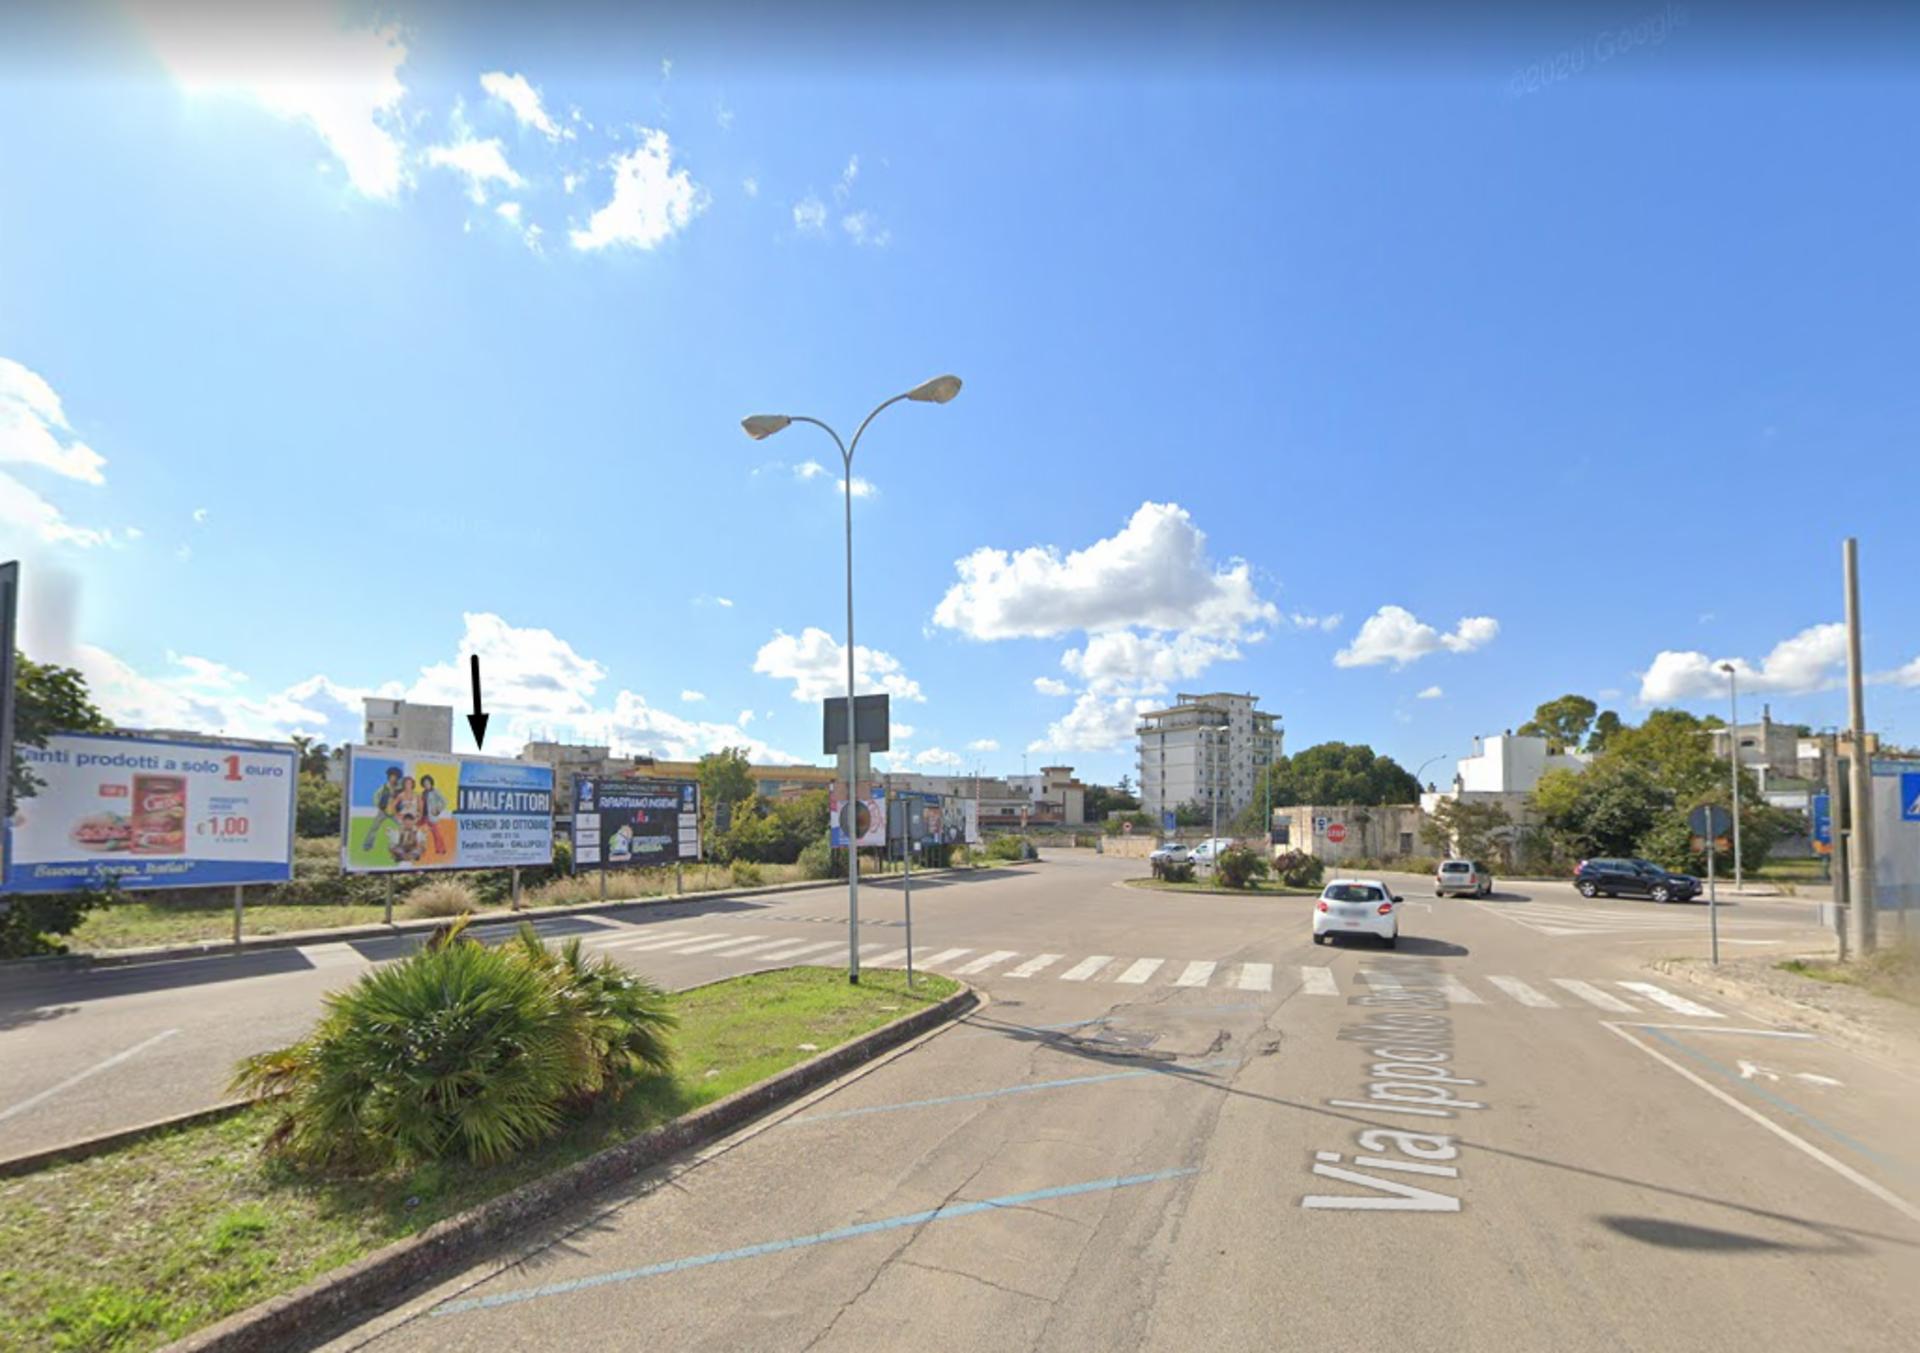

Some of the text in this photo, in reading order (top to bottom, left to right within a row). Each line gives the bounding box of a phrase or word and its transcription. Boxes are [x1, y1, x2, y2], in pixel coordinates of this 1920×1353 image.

[17, 747, 284, 781] anti prodotti a solo 1 euro
[467, 790, 550, 812] MALFATTORI
[207, 816, 249, 838] 1,00
